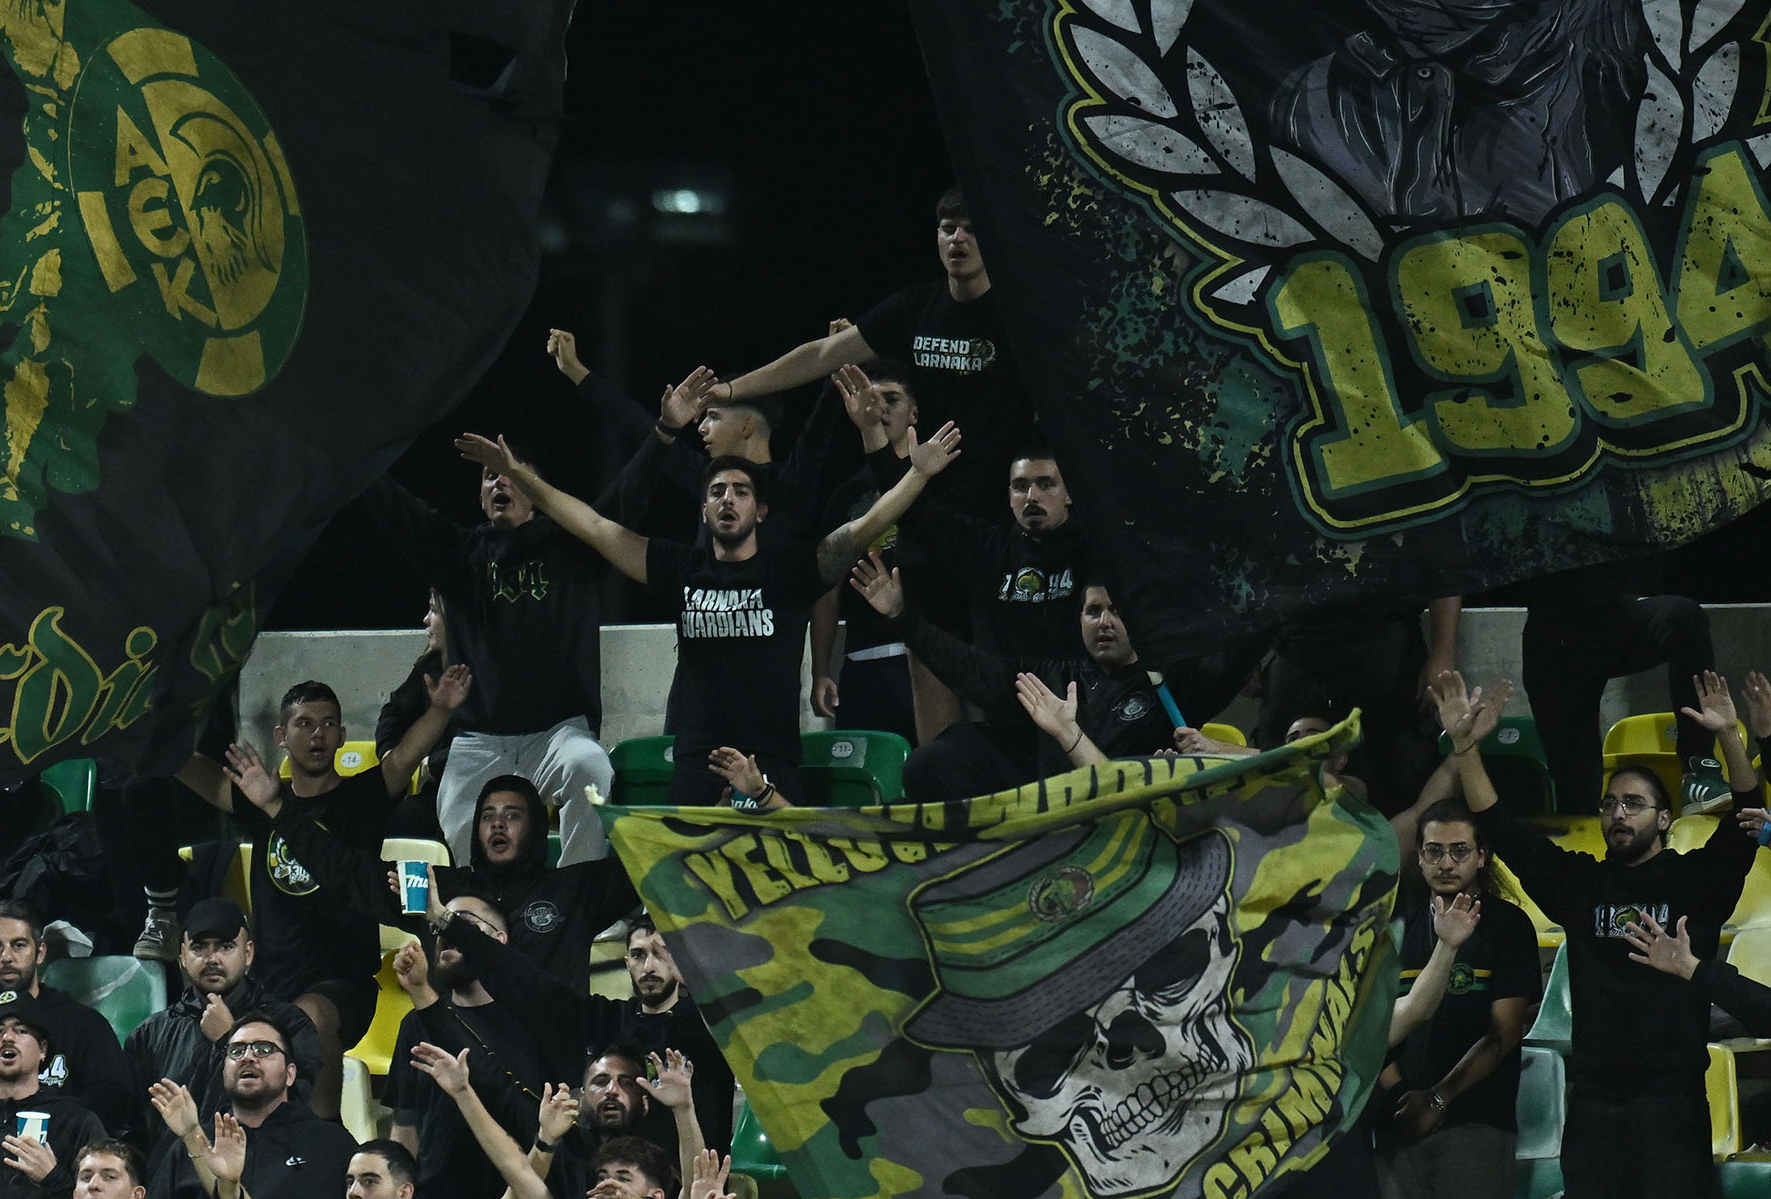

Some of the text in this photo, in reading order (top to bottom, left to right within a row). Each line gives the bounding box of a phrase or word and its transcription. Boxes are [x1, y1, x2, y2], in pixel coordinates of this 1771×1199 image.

[1267, 140, 1771, 498] 1994
[913, 336, 970, 354] DEFEND
[914, 352, 983, 372] LARNAKA
[683, 586, 765, 613] LARNAKA
